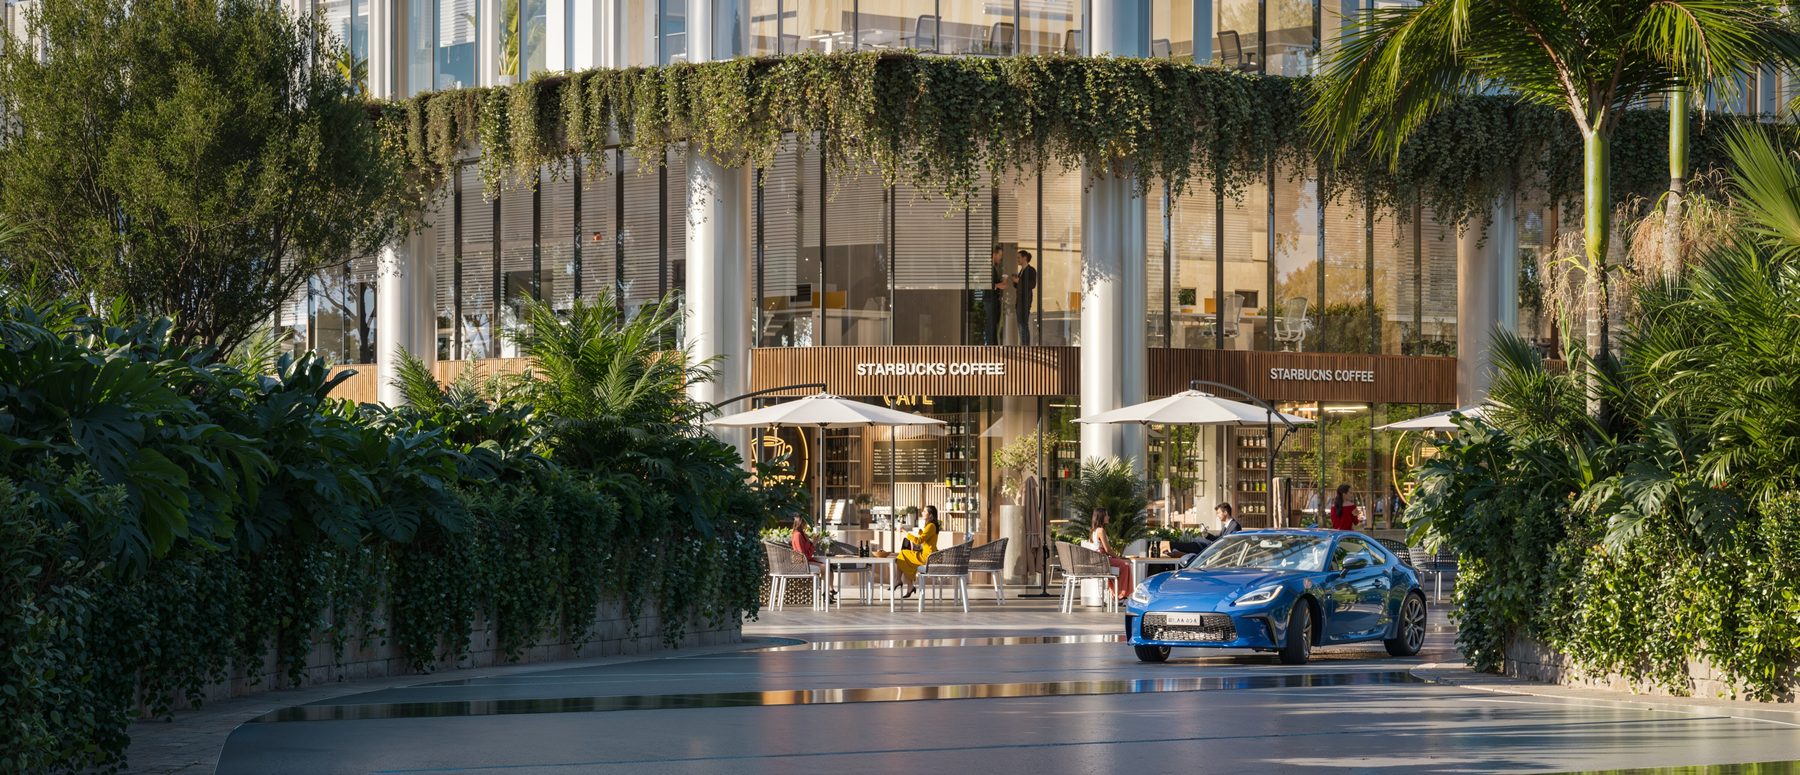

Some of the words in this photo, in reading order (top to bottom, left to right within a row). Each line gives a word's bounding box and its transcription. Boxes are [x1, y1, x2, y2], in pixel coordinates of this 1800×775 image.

[857, 363, 946, 376] STARBUCKS
[949, 363, 1005, 376] COFFEE
[1270, 367, 1333, 381] STARBUCNS
[1334, 369, 1374, 382] COFFEE
